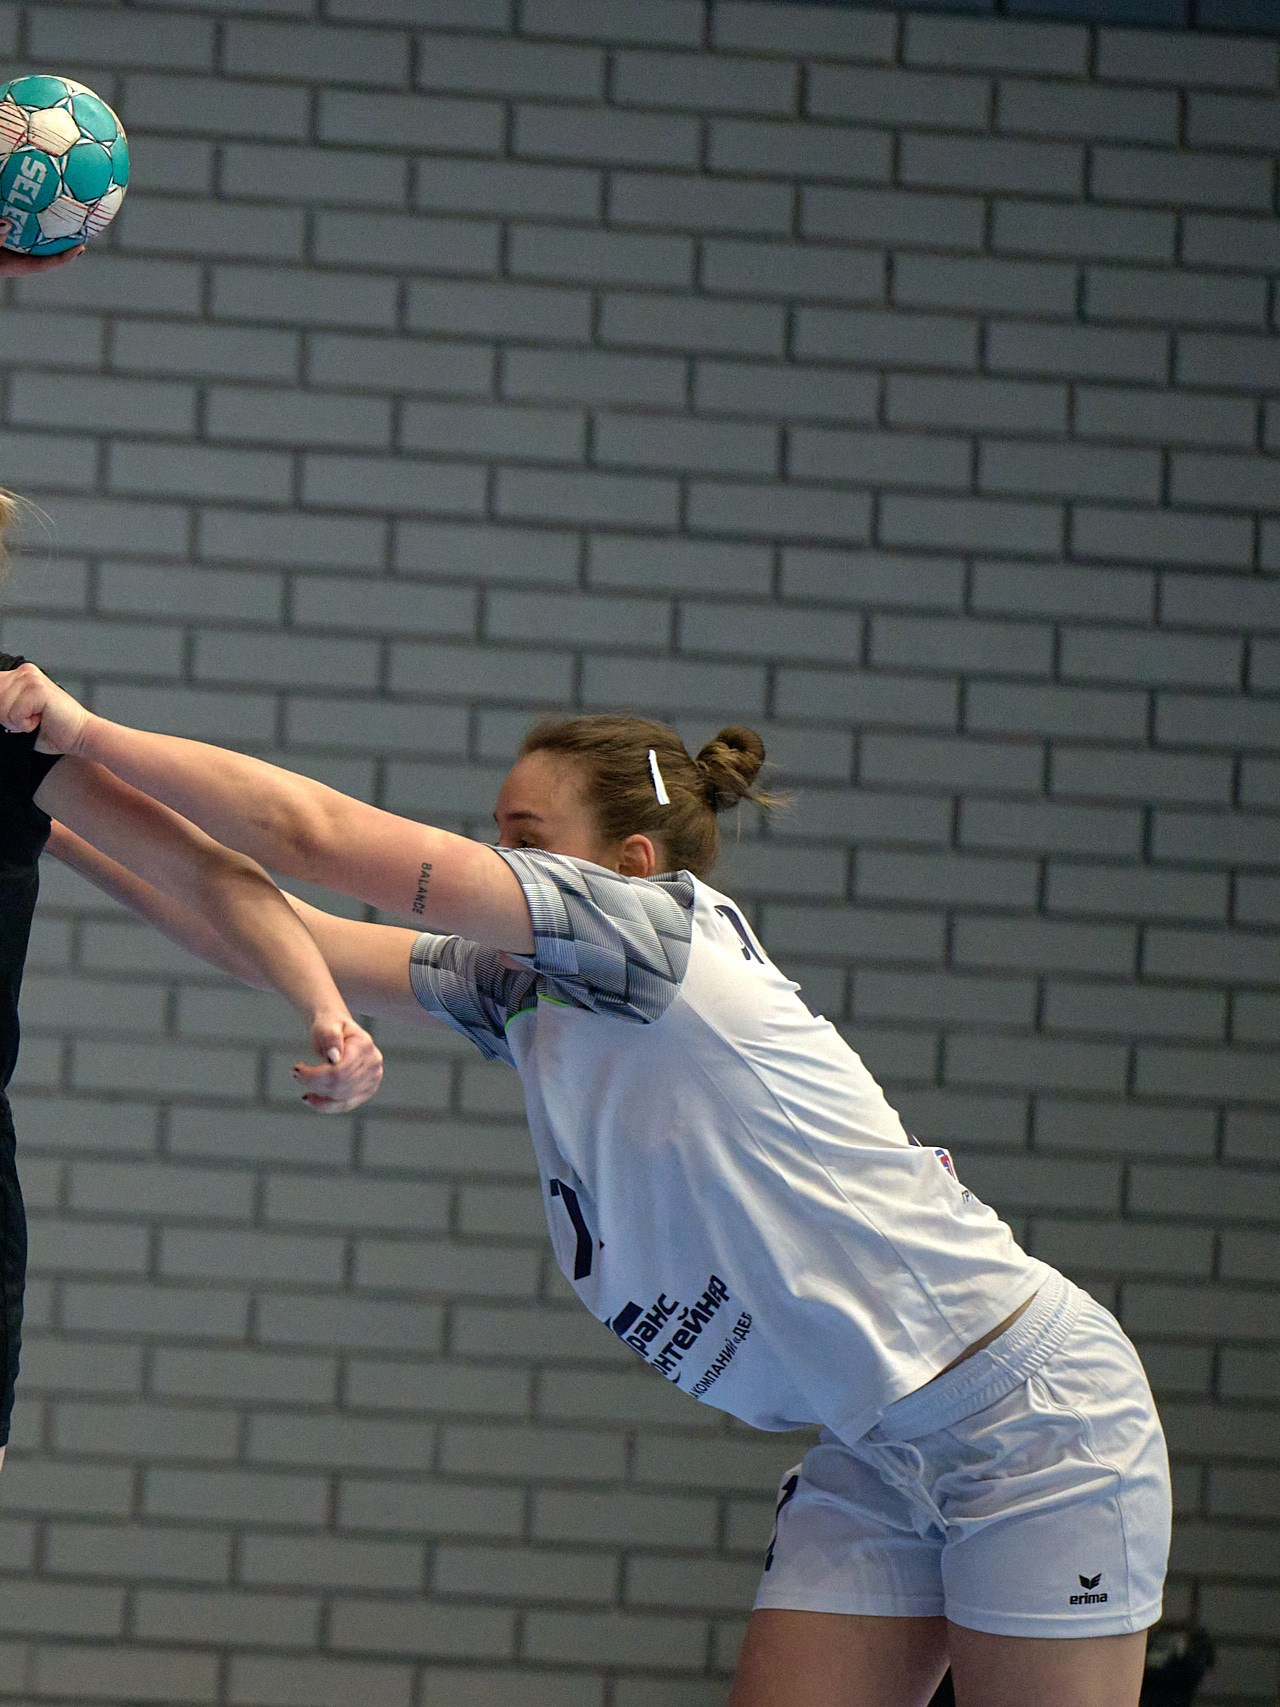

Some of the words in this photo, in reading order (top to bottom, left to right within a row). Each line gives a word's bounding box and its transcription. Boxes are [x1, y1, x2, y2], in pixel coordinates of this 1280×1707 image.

[411, 862, 432, 915] BALANCE
[623, 1292, 680, 1358] ранс
[1068, 1592, 1109, 1606] erima
